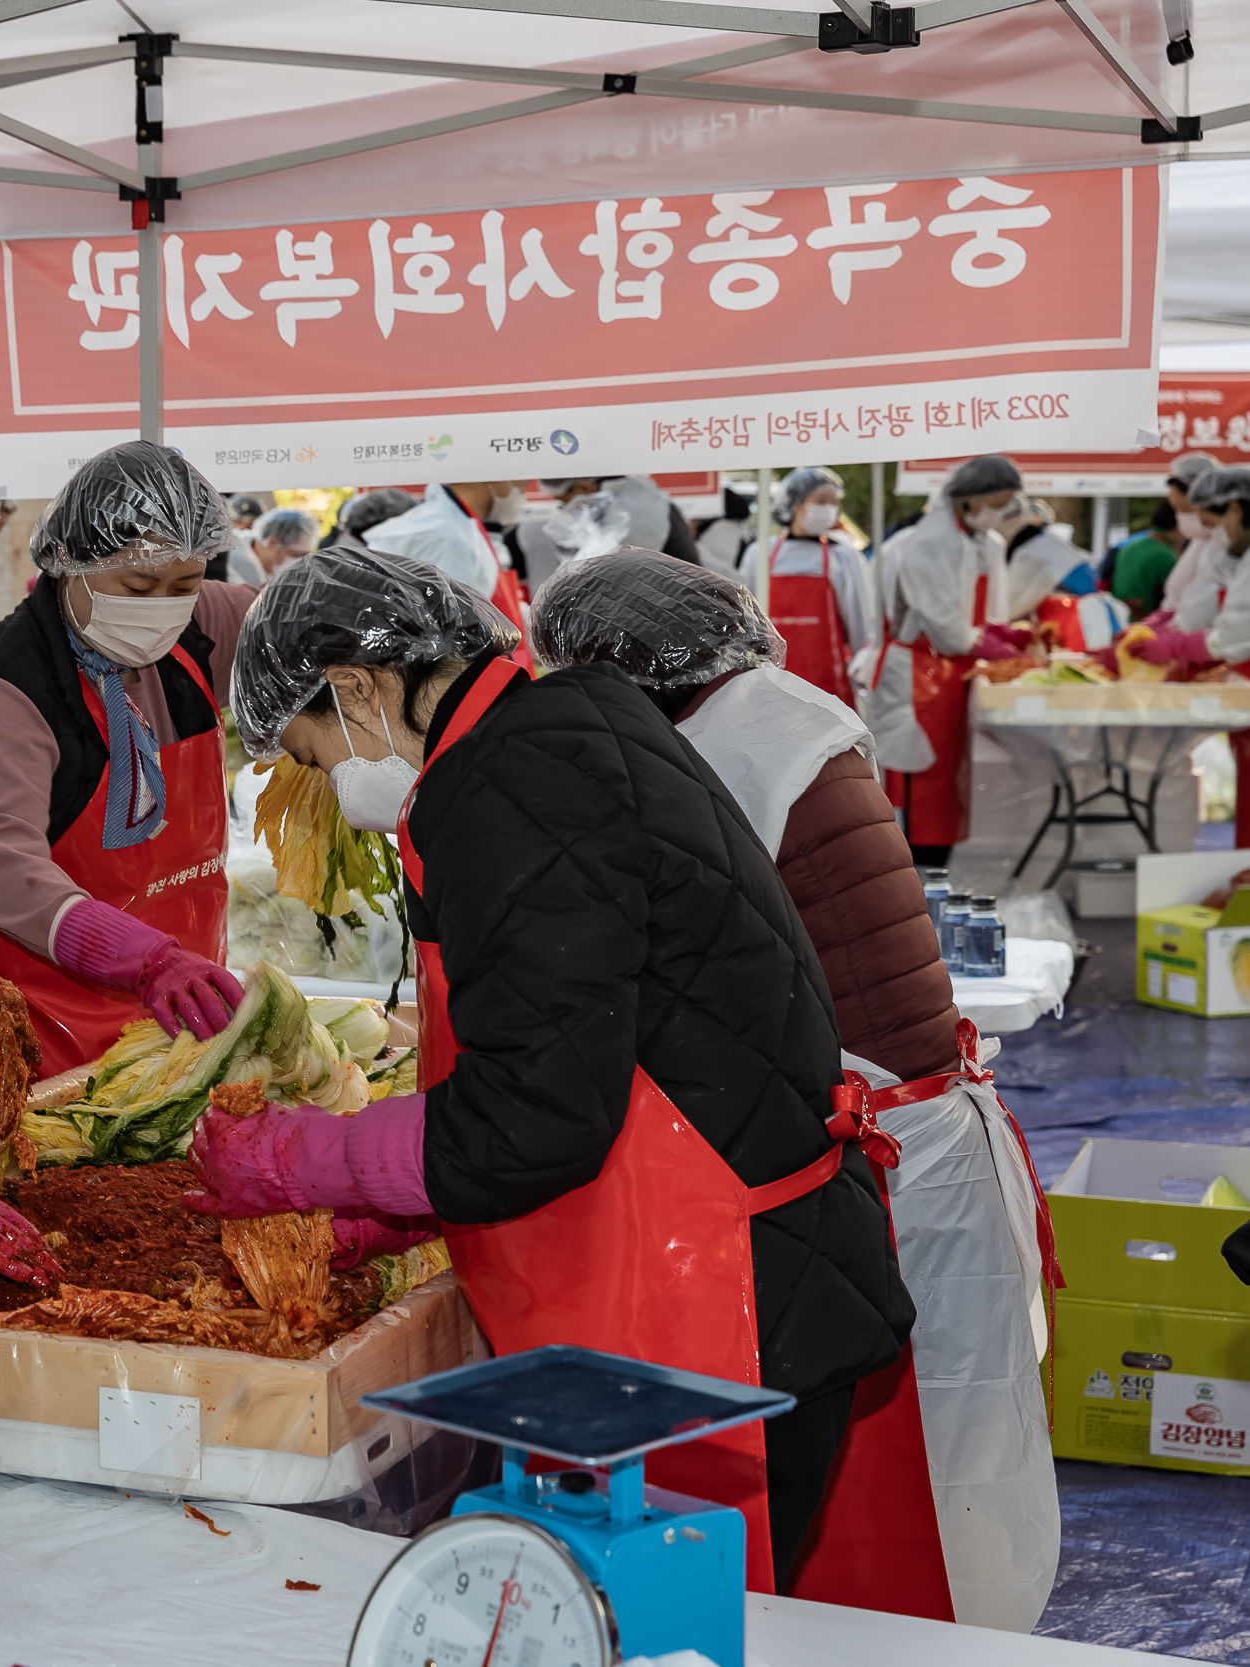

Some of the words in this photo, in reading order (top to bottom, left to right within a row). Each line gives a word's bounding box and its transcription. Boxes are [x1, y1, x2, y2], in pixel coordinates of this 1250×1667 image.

[146, 877, 167, 898] 광진
[167, 864, 199, 887] 사랑의
[1160, 1421, 1247, 1450] 김장양념
[455, 1571, 470, 1595] 9
[412, 1612, 427, 1637] 8
[551, 1602, 561, 1625] 1
